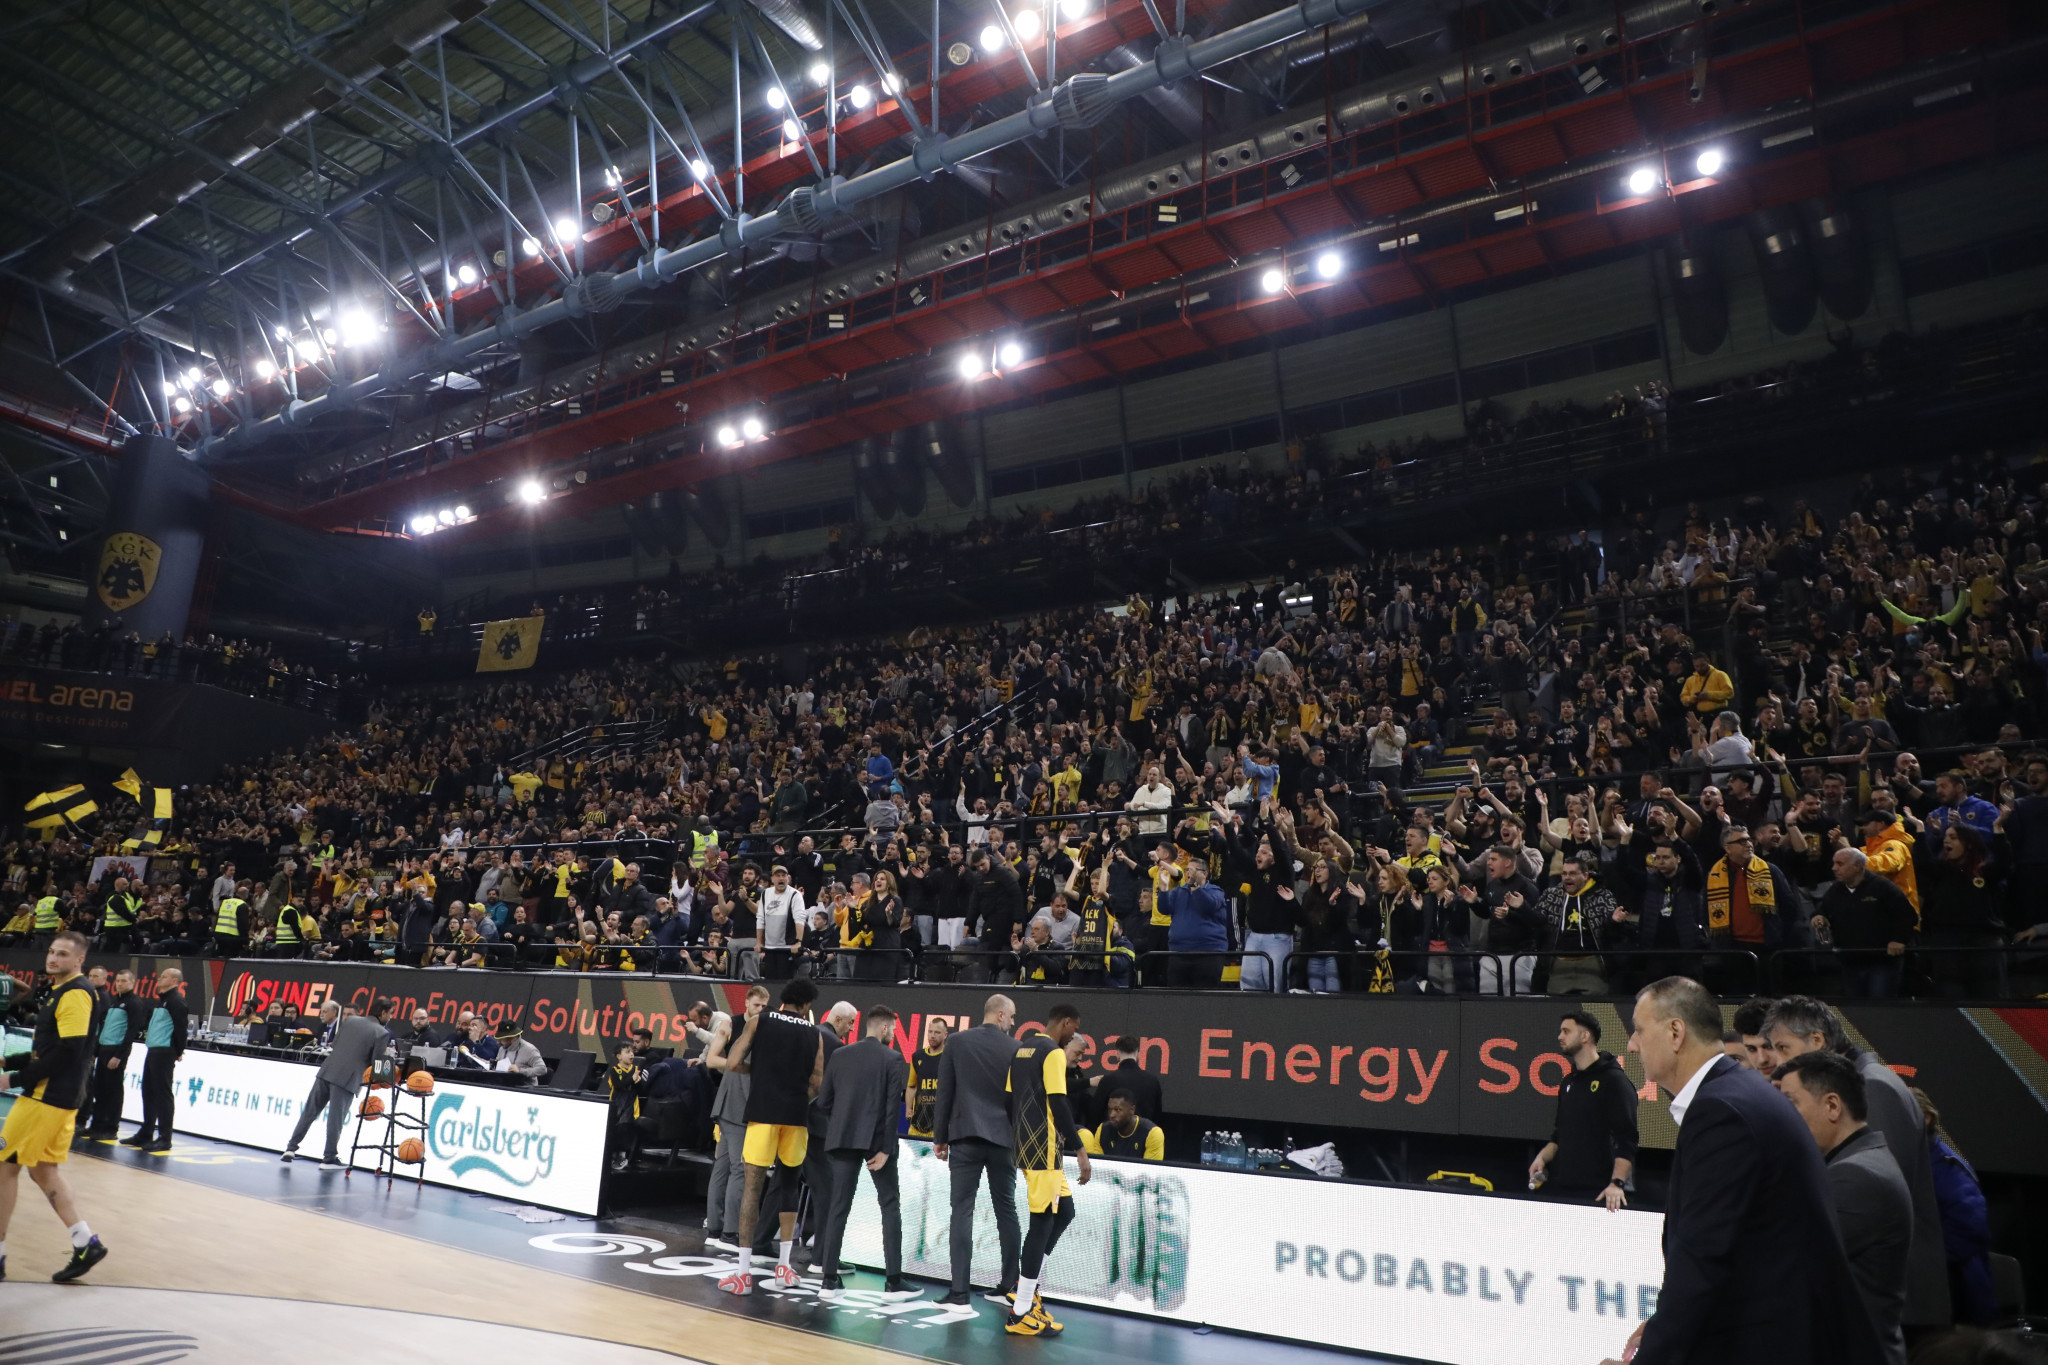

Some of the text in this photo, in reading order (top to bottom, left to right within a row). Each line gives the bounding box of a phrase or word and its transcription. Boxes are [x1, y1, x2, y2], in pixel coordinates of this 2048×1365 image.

[49, 684, 134, 711] arena
[35, 712, 128, 728] Destination
[1084, 909, 1099, 919] AEK
[1084, 921, 1096, 933] 30
[351, 986, 687, 1041] Clan Energy Solutions
[769, 1011, 812, 1027] macron
[1198, 1028, 1449, 1105] Energy
[921, 1078, 938, 1090] AEK
[207, 1086, 239, 1107] BEER
[245, 1092, 260, 1111] IN
[267, 1095, 292, 1117] THE
[428, 1092, 558, 1180] Carlsberg
[1275, 1240, 1661, 1321] PROBABLY THE
[765, 1292, 934, 1329] ALLIANCE
